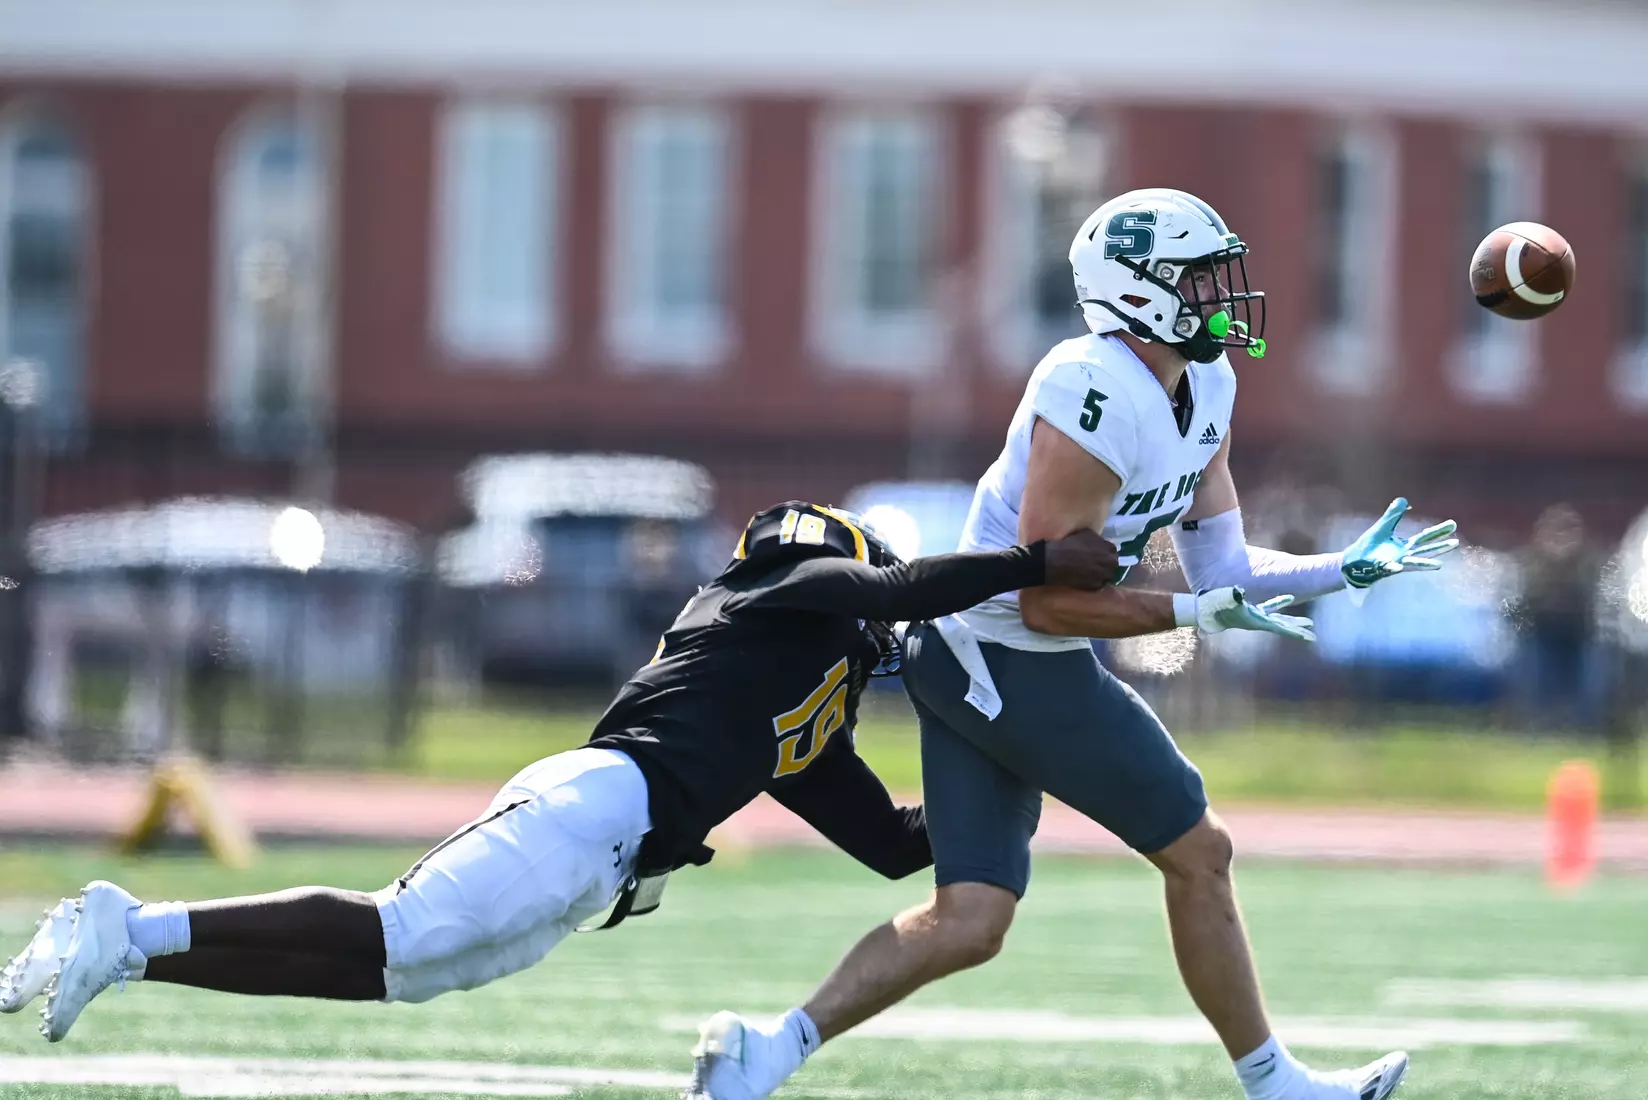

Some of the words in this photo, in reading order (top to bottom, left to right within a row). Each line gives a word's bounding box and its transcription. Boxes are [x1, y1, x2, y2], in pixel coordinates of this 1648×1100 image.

[1104, 208, 1159, 260] S
[1079, 387, 1109, 433] 5
[1198, 435, 1220, 445] adda
[779, 508, 827, 546] 19
[772, 655, 849, 779] 19
